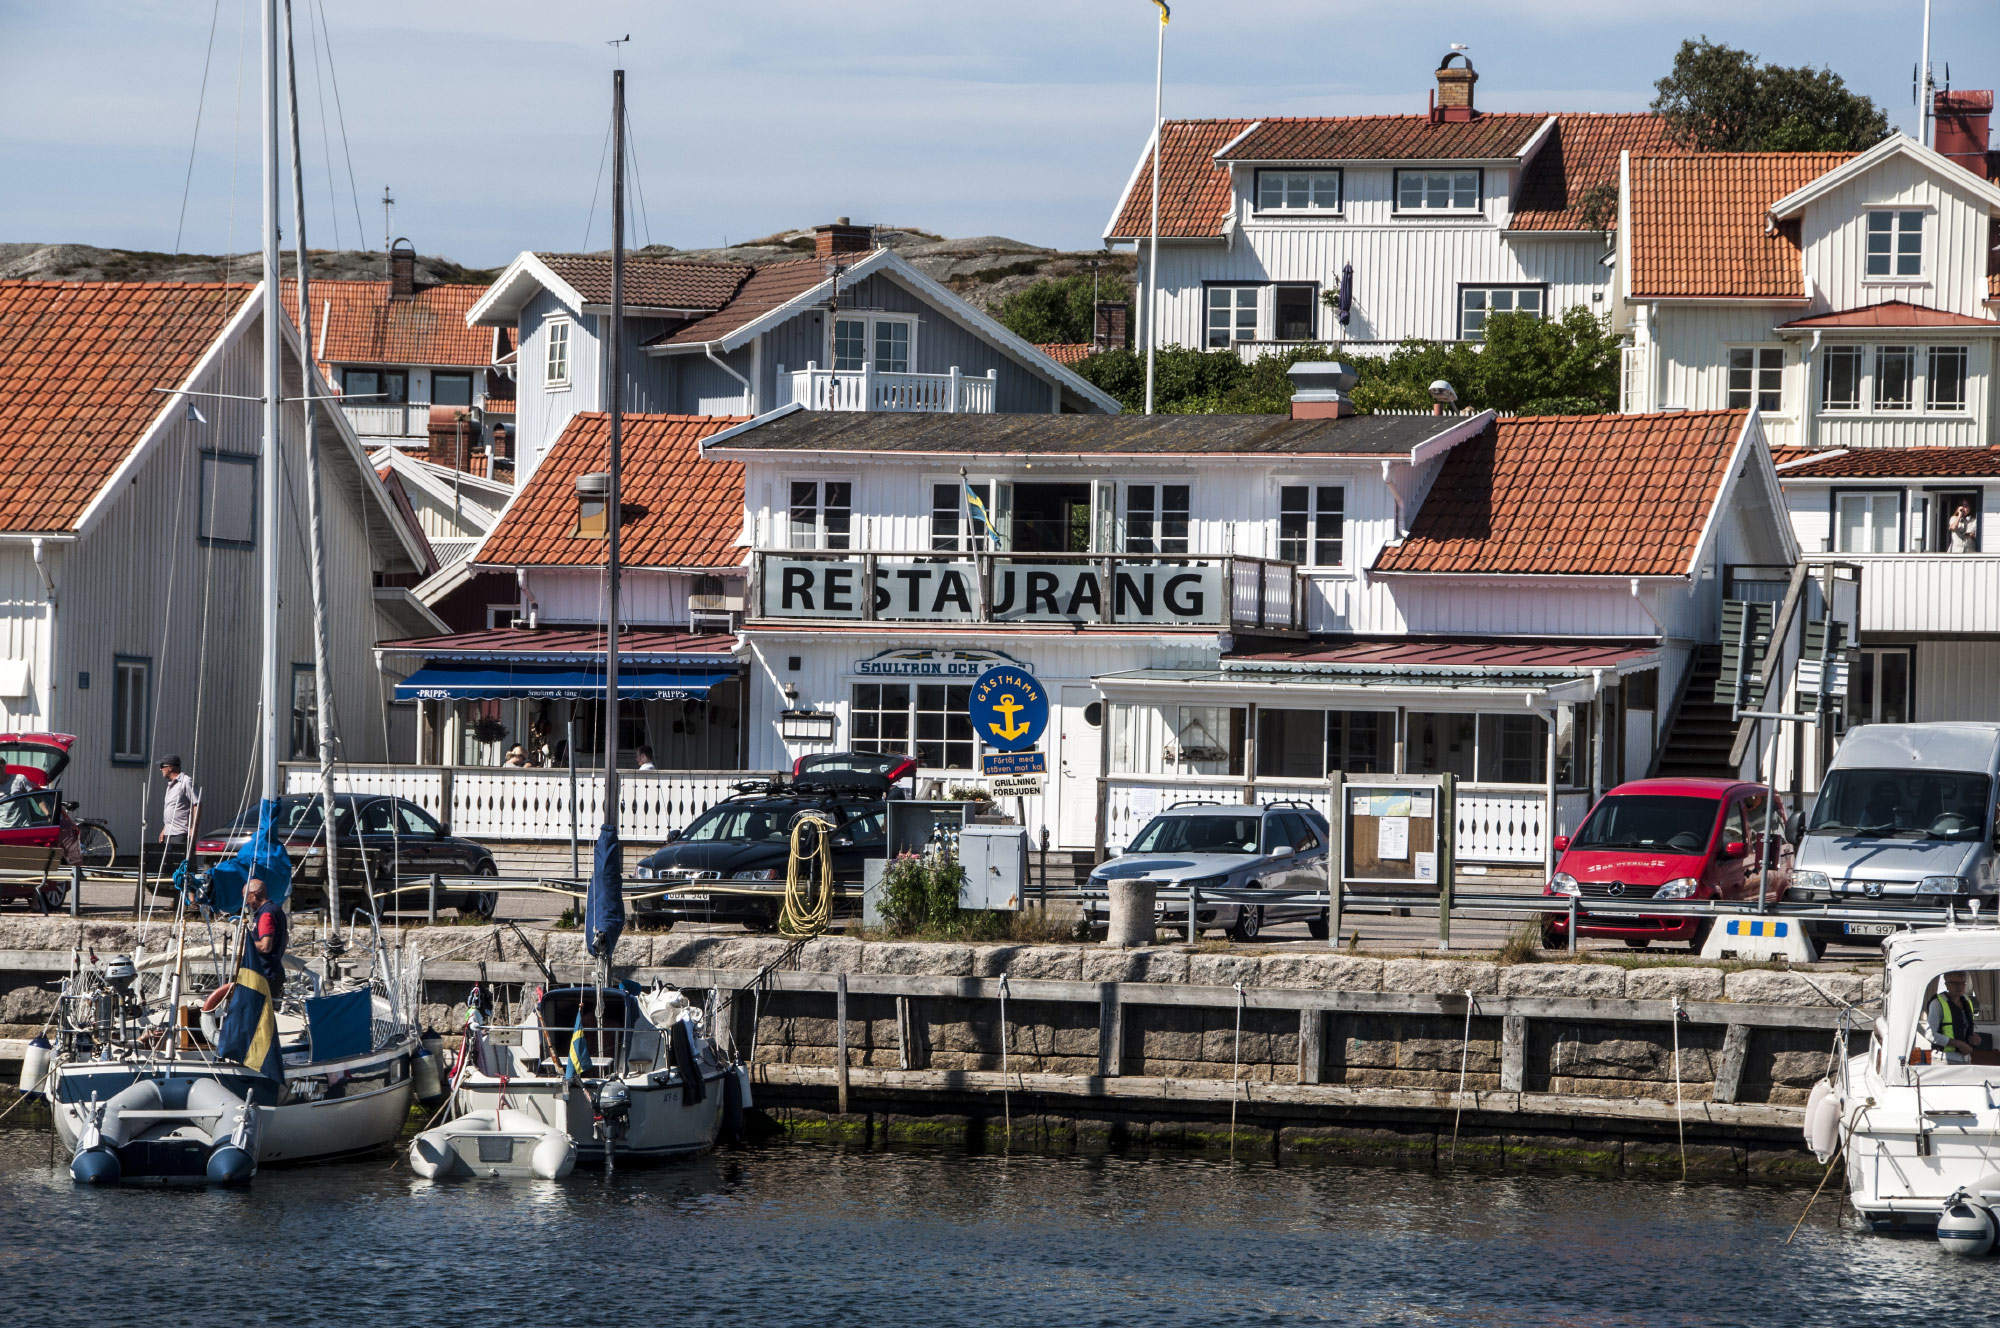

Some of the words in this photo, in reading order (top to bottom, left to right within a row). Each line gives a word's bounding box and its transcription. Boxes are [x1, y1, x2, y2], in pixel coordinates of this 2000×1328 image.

[781, 566, 1204, 617] RESTAURANG
[860, 662, 942, 674] SMULTRON
[947, 663, 979, 674] OCH
[977, 674, 1038, 702] GÄSTHAMN
[993, 756, 1015, 765] Förtöj
[1018, 755, 1034, 763] med
[1014, 764, 1029, 772] mot
[1032, 763, 1043, 771] kaj
[994, 777, 1037, 787] GRILLNING
[993, 786, 1041, 796] FÖRBJUDEN
[1850, 924, 1869, 934] WFY
[1875, 925, 1895, 935] 997
